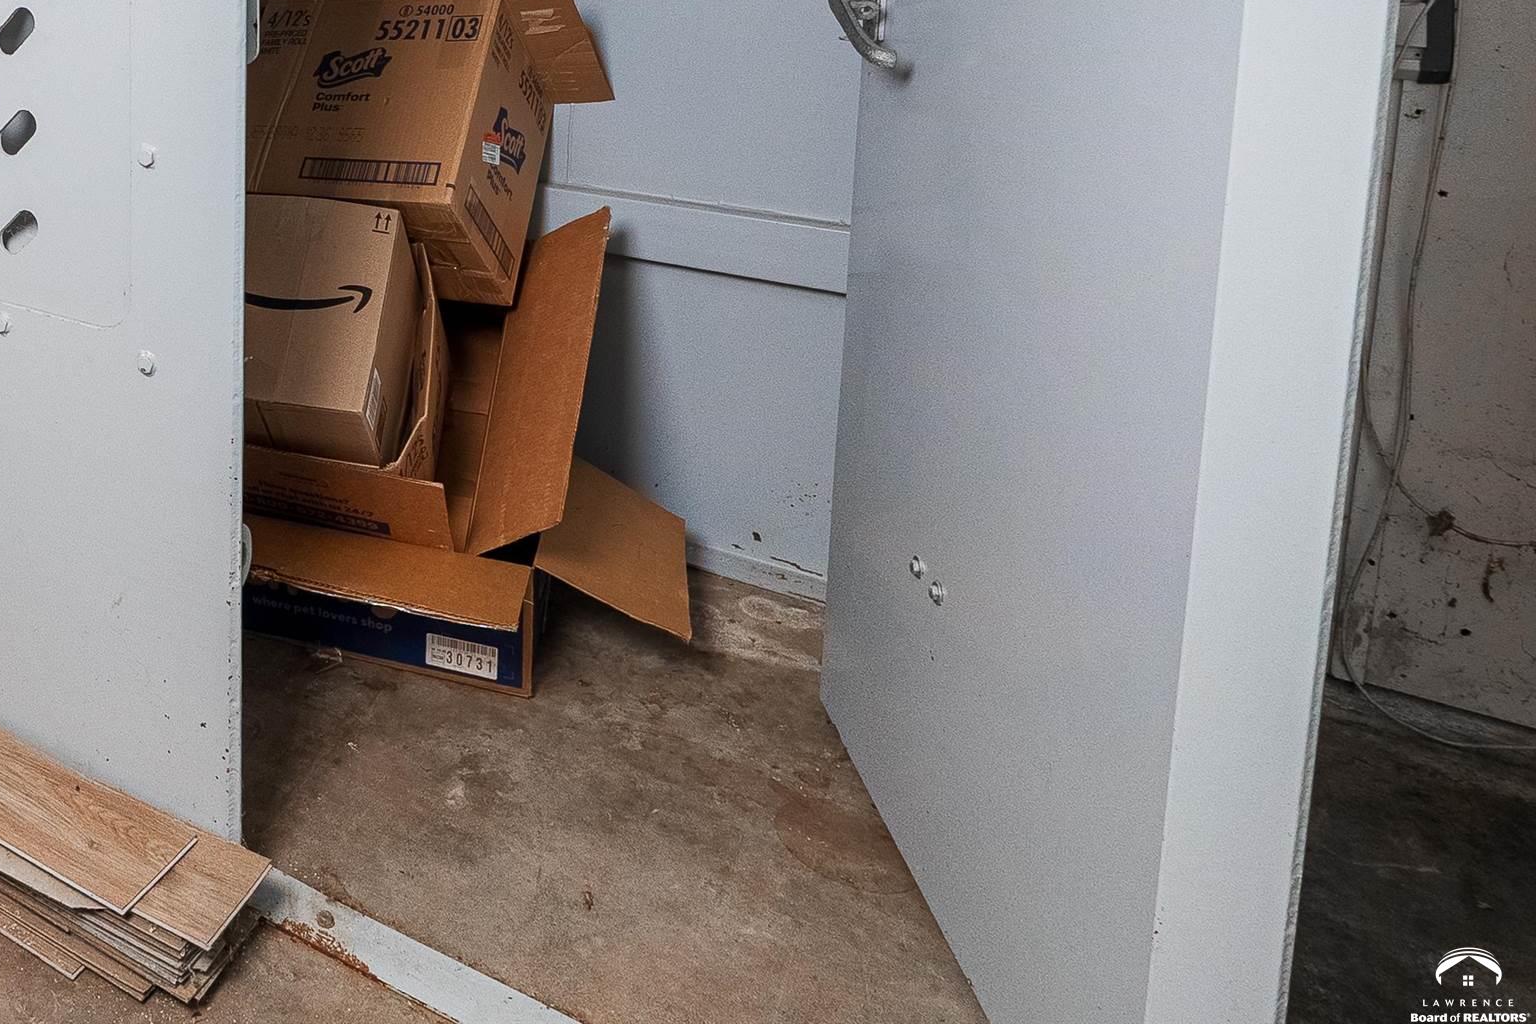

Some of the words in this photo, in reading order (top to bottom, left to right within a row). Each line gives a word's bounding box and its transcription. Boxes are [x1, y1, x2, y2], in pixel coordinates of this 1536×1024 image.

[415, 3, 455, 16] 54000
[321, 48, 384, 81] Scott
[312, 102, 340, 112] Plus
[315, 91, 371, 102] Comfort
[500, 117, 525, 160] Scott
[252, 595, 291, 611] where
[293, 603, 317, 616] pet
[318, 607, 358, 625] lovers
[360, 616, 393, 634] shop
[446, 650, 492, 673] 30731
